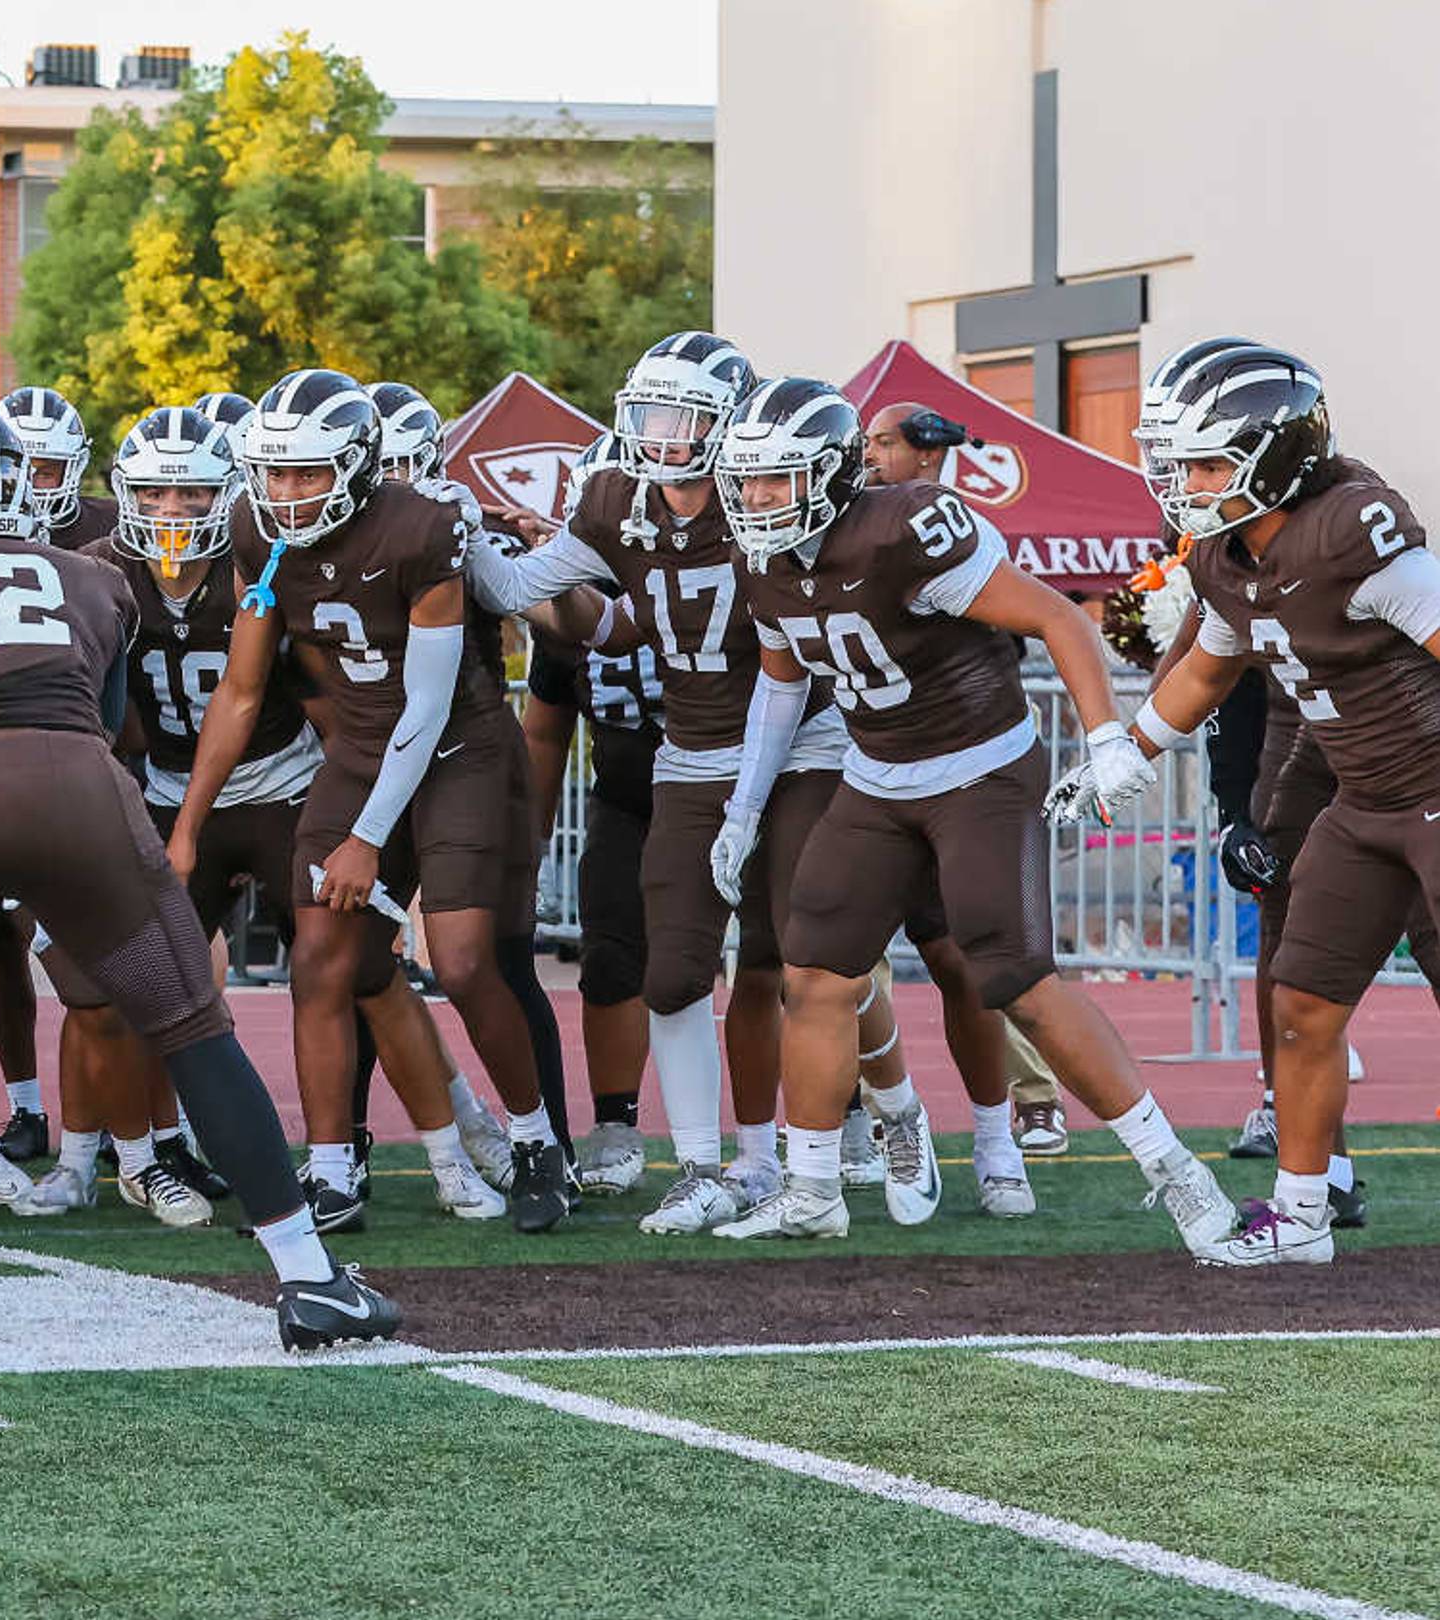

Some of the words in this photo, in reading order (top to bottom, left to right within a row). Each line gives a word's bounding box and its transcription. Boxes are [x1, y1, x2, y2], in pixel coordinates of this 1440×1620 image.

[909, 494, 973, 557] 50
[1360, 501, 1405, 557] 2
[313, 602, 389, 684] 3
[645, 563, 736, 672] 17
[778, 612, 912, 711] 50
[1251, 619, 1340, 719] 2
